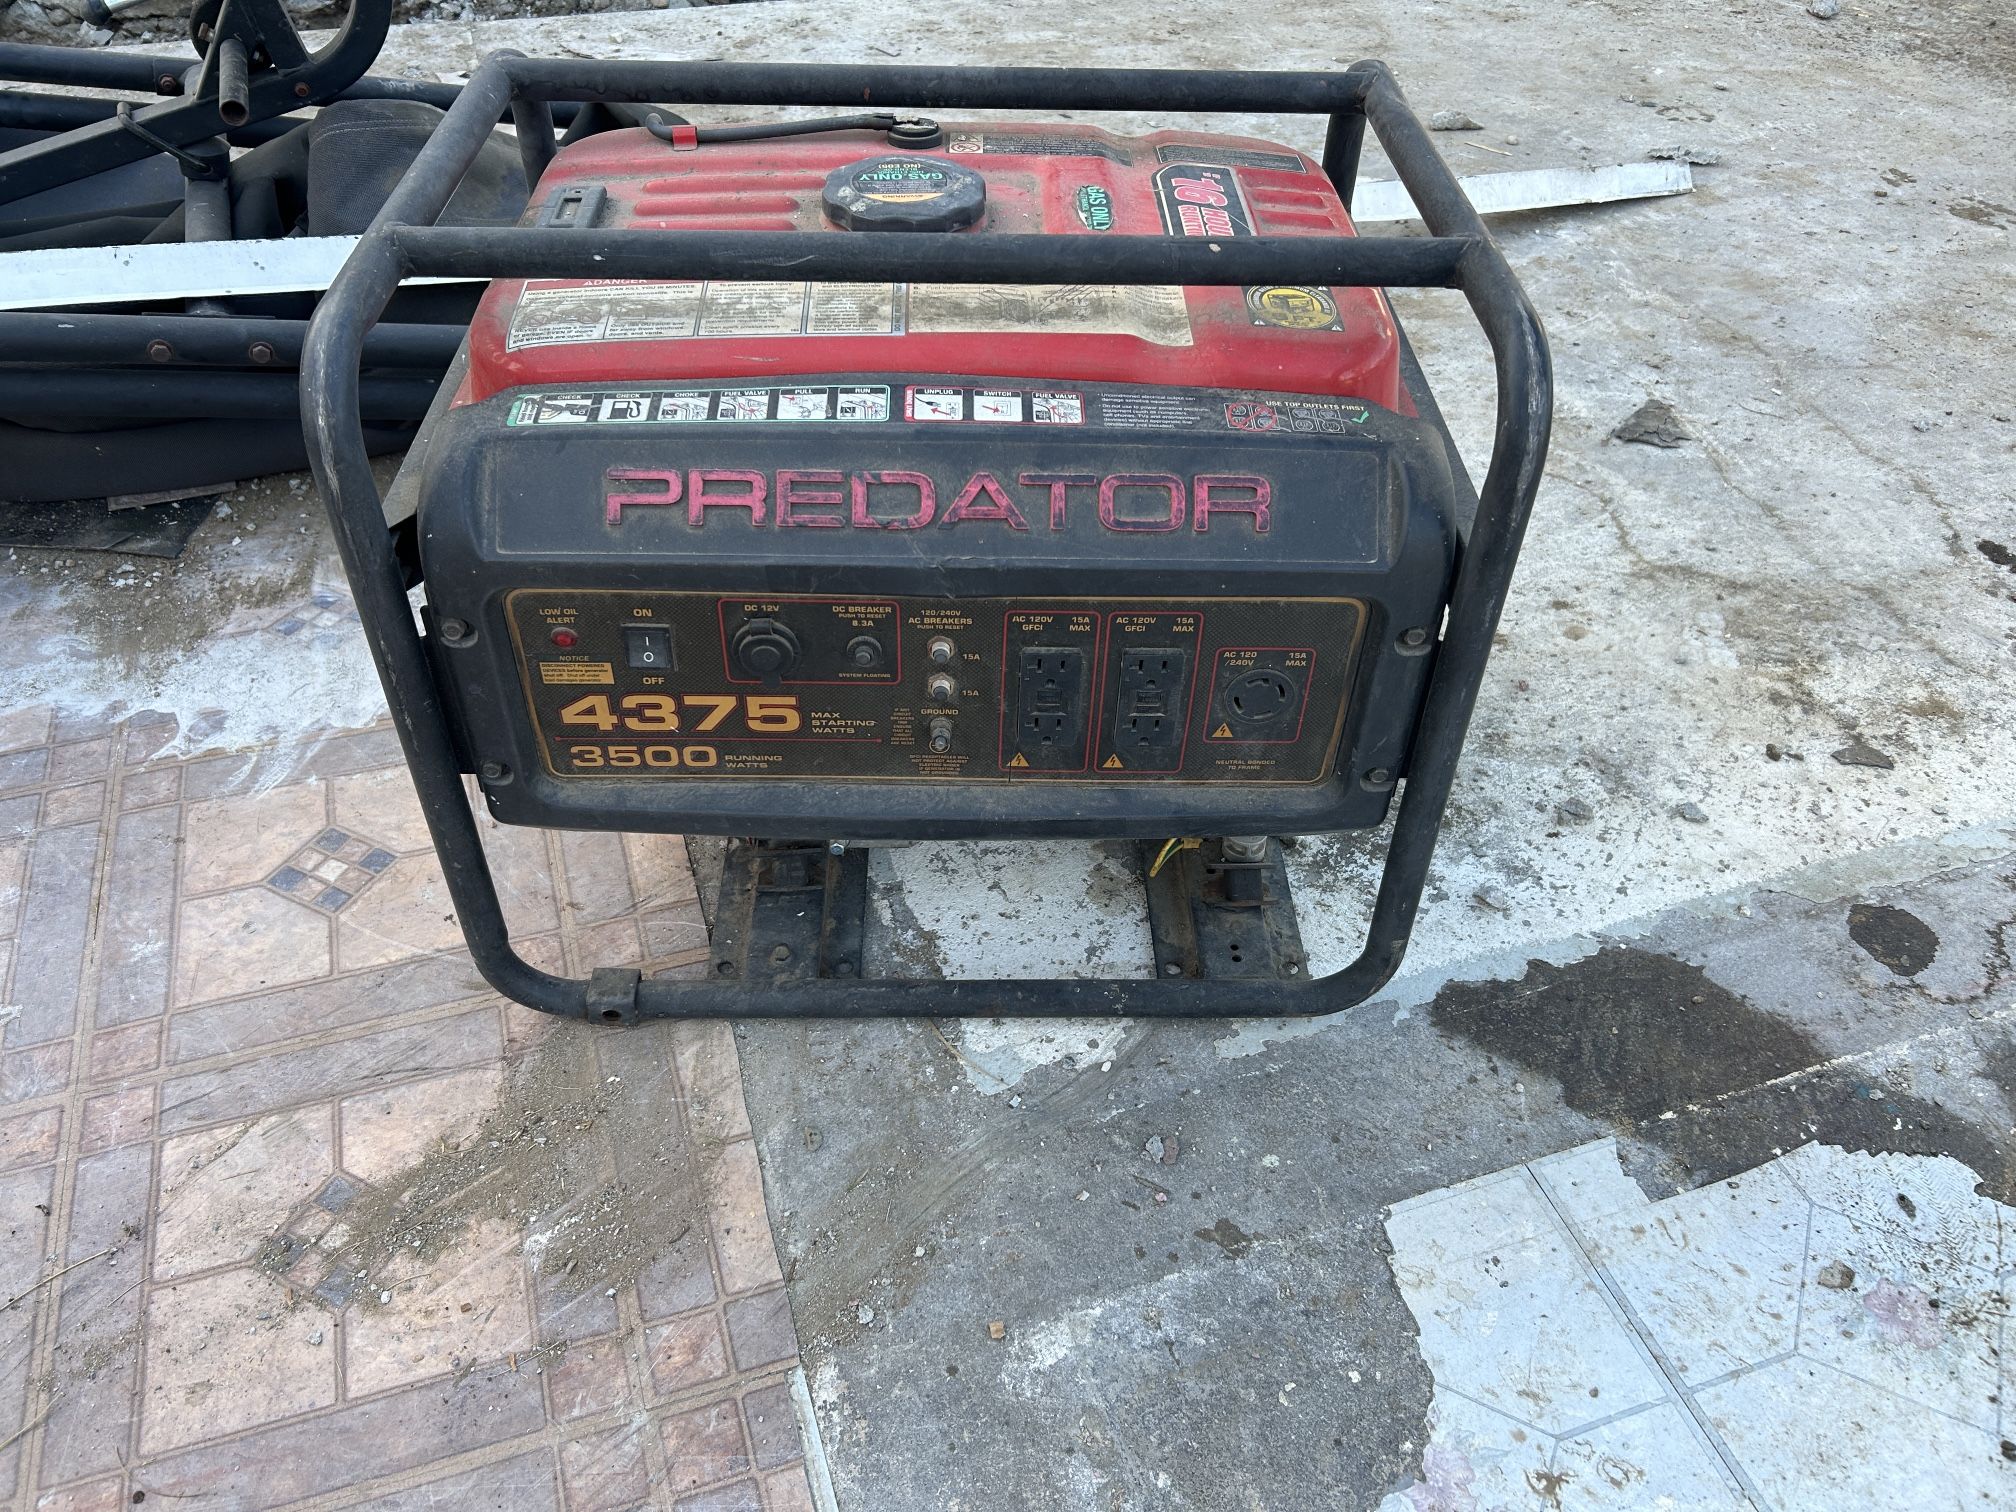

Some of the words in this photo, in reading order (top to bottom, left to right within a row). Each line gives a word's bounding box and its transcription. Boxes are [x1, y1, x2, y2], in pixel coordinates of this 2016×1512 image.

[1087, 186, 1107, 205] GAS
[1171, 178, 1228, 207] 16
[1091, 206, 1110, 230] ONLY
[1201, 207, 1235, 236] HOU
[1302, 402, 1341, 410] OUTLETS
[606, 468, 1272, 532] PREDATOR
[540, 608, 561, 616] LOW
[744, 604, 758, 612] DC
[760, 604, 780, 612] 12V
[832, 605, 846, 613] DC
[848, 606, 892, 614] BREAKER
[632, 608, 653, 617] ON
[923, 617, 973, 625] BREAKERS
[1012, 615, 1026, 623] AC
[1116, 616, 1130, 624] AC
[642, 677, 665, 685] OFF
[559, 693, 801, 733] 4375
[811, 711, 841, 719] MAX
[811, 719, 877, 727] STARTING
[569, 745, 719, 768] 3500
